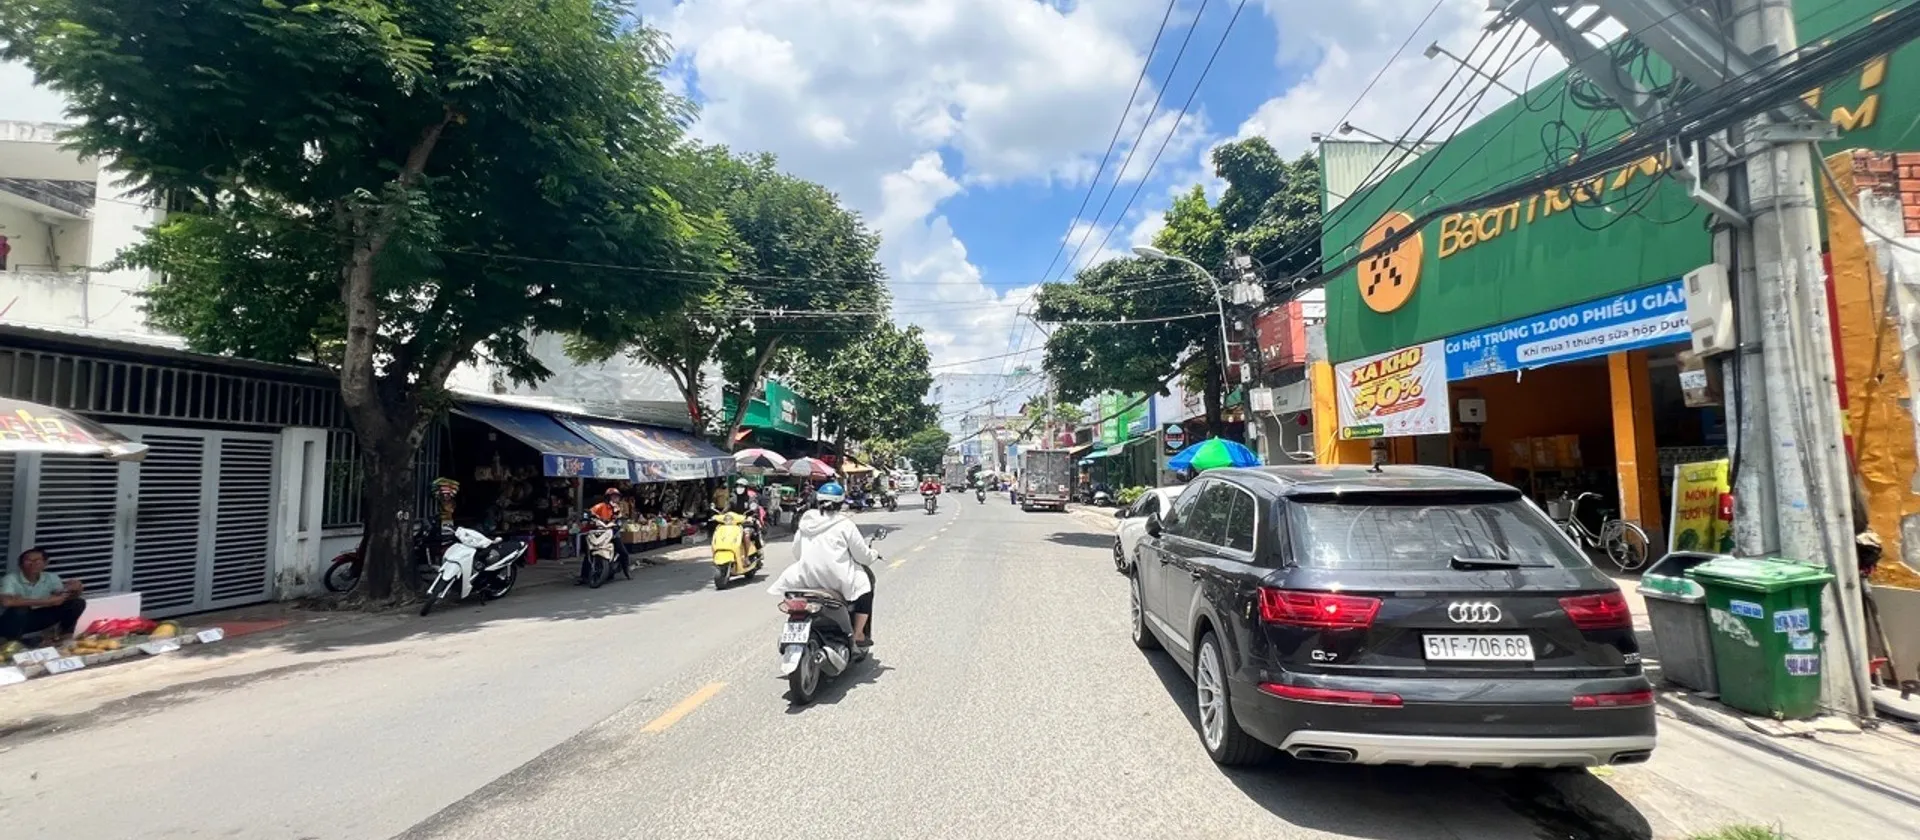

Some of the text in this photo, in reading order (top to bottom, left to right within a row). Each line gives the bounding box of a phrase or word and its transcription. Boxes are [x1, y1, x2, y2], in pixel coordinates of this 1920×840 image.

[1445, 341, 1461, 354] Cơ
[1462, 335, 1481, 352] hội
[1482, 326, 1529, 346] TRÚNG
[1530, 313, 1579, 336] 12.000
[1582, 296, 1638, 324] PHIẾU
[1380, 347, 1423, 377] KHO
[1522, 345, 1541, 358] Khi
[1541, 342, 1563, 354] mua
[1354, 376, 1423, 411] 50%
[1311, 648, 1338, 662] Q7
[1427, 635, 1529, 658] 51F-706.68
